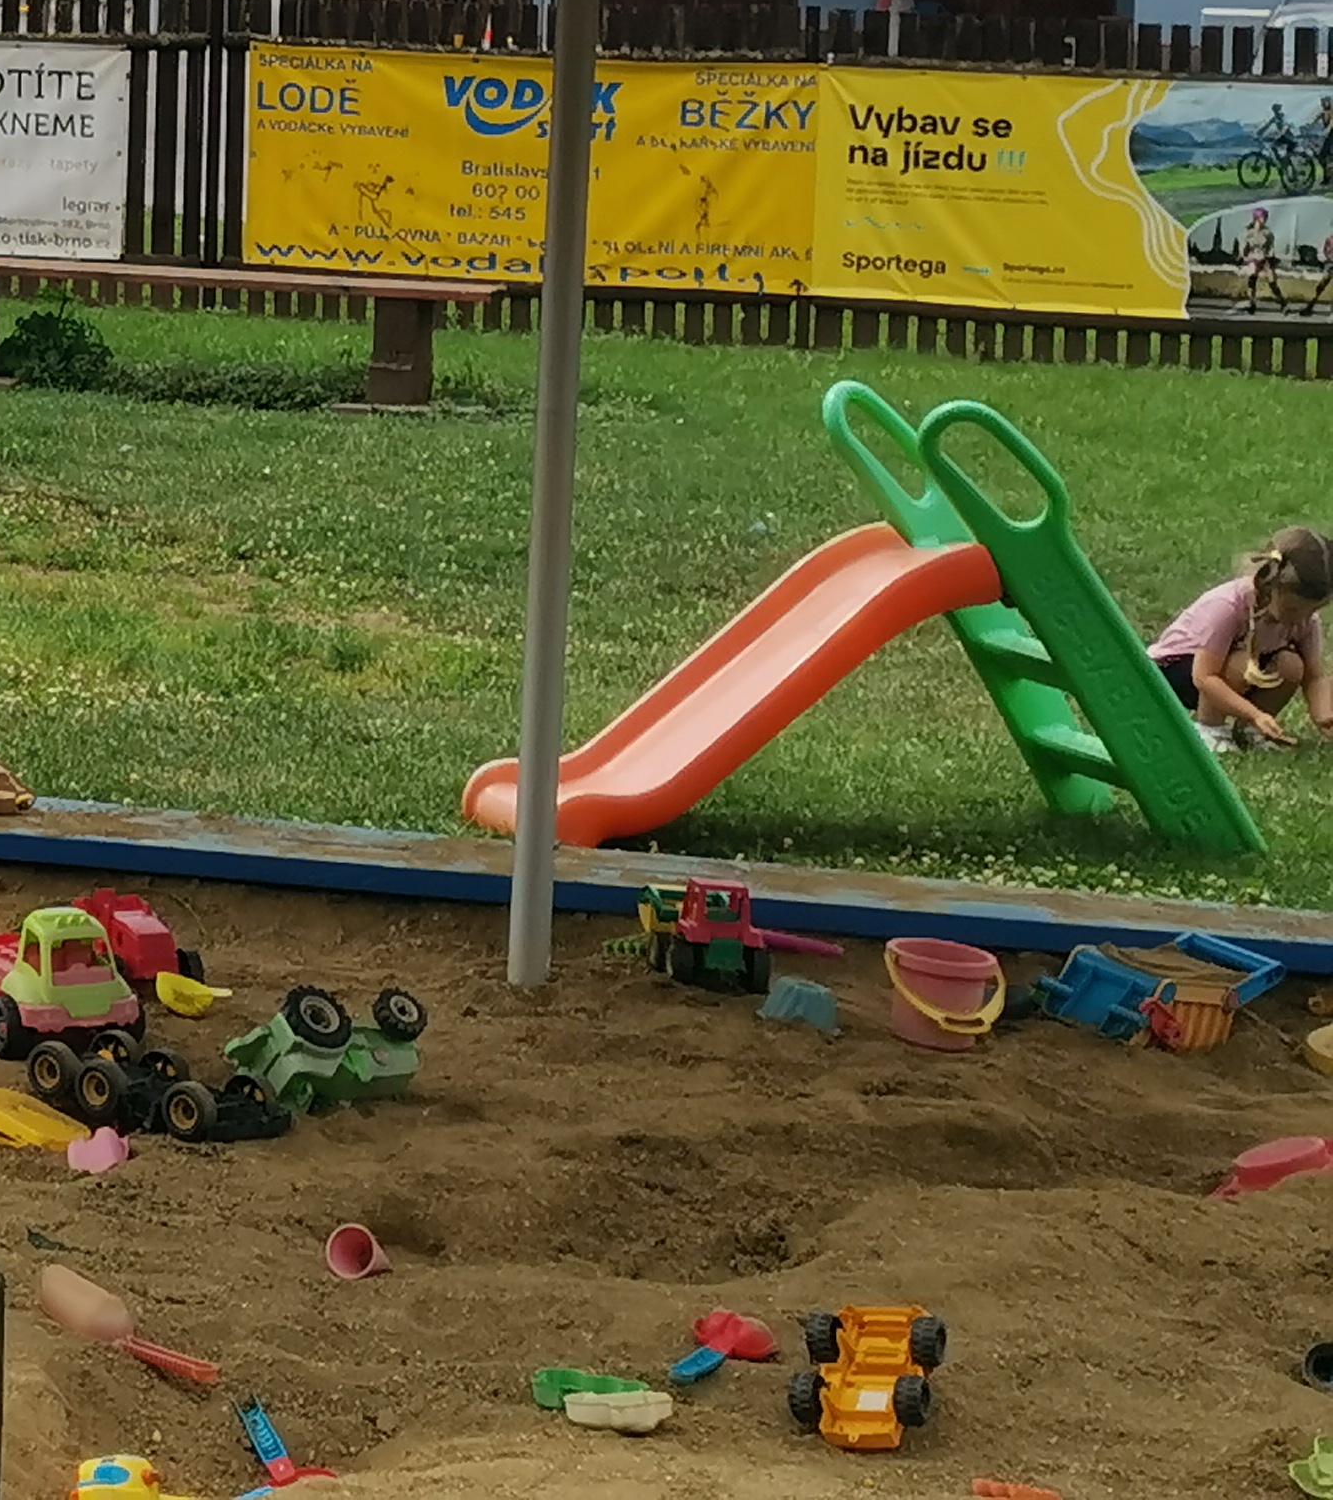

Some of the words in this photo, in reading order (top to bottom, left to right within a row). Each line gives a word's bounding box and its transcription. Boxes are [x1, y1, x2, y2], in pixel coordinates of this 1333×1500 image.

[259, 52, 347, 71] SPECIÁLKA
[351, 59, 374, 73] NA
[256, 77, 362, 117] LODĚ
[443, 75, 625, 115] VODK
[679, 89, 817, 132] BĚŽKY
[257, 118, 266, 131] A
[848, 103, 961, 139] Vybav
[972, 116, 1013, 138] se
[49, 157, 99, 175] tapety
[847, 143, 888, 167] na
[899, 140, 988, 176] jízdu
[841, 251, 947, 278] Sportega
